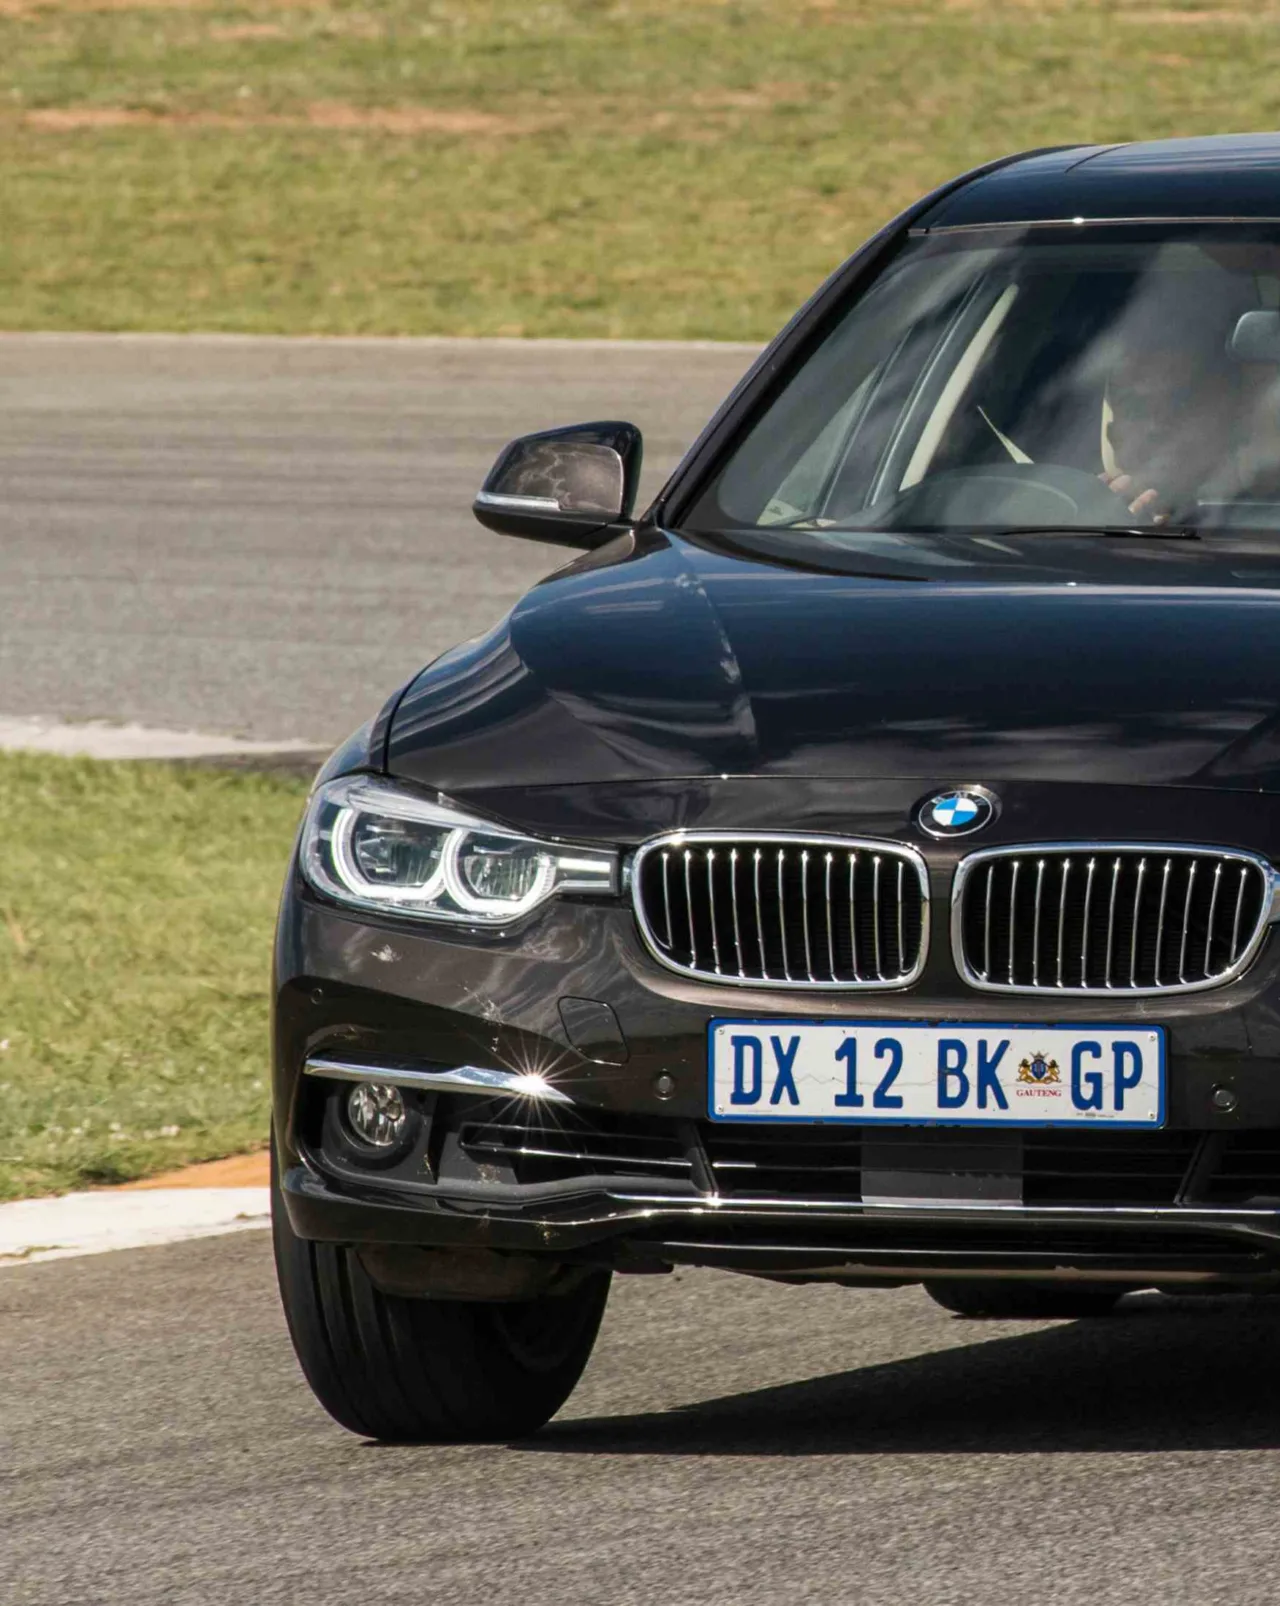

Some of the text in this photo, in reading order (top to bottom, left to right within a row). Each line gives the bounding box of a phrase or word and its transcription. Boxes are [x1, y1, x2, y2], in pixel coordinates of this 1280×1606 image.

[730, 1035, 1143, 1110] DX 12 BK GP
[1016, 1089, 1062, 1097] GAUTENG
